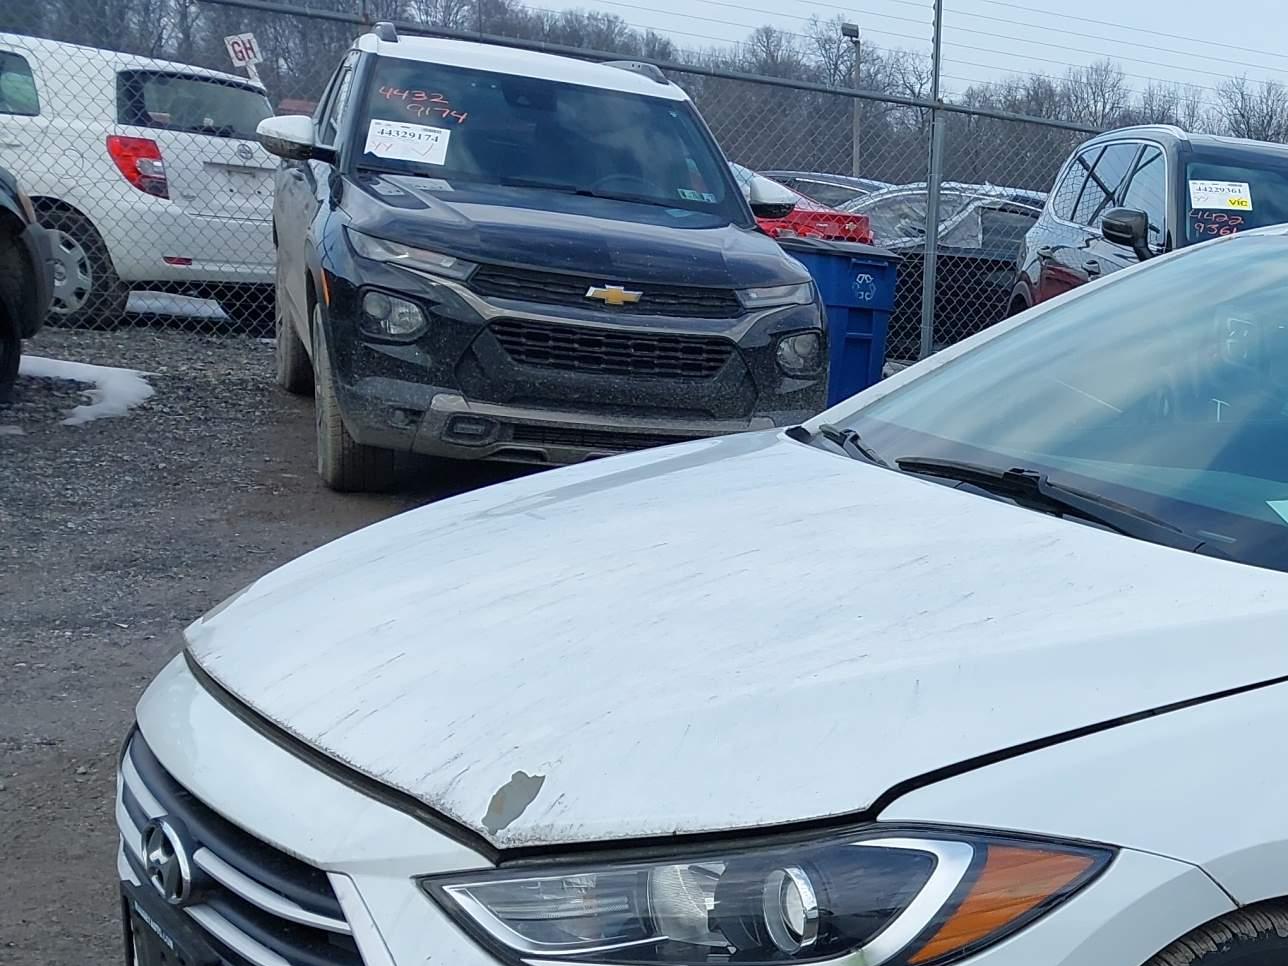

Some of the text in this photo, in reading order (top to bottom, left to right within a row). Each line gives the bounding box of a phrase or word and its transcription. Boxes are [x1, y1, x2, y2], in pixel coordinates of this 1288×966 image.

[231, 38, 257, 62] GH
[378, 86, 449, 104] 4432
[406, 103, 468, 124] 9174
[376, 128, 440, 143] 44329174
[1194, 222, 1237, 236] 9361
